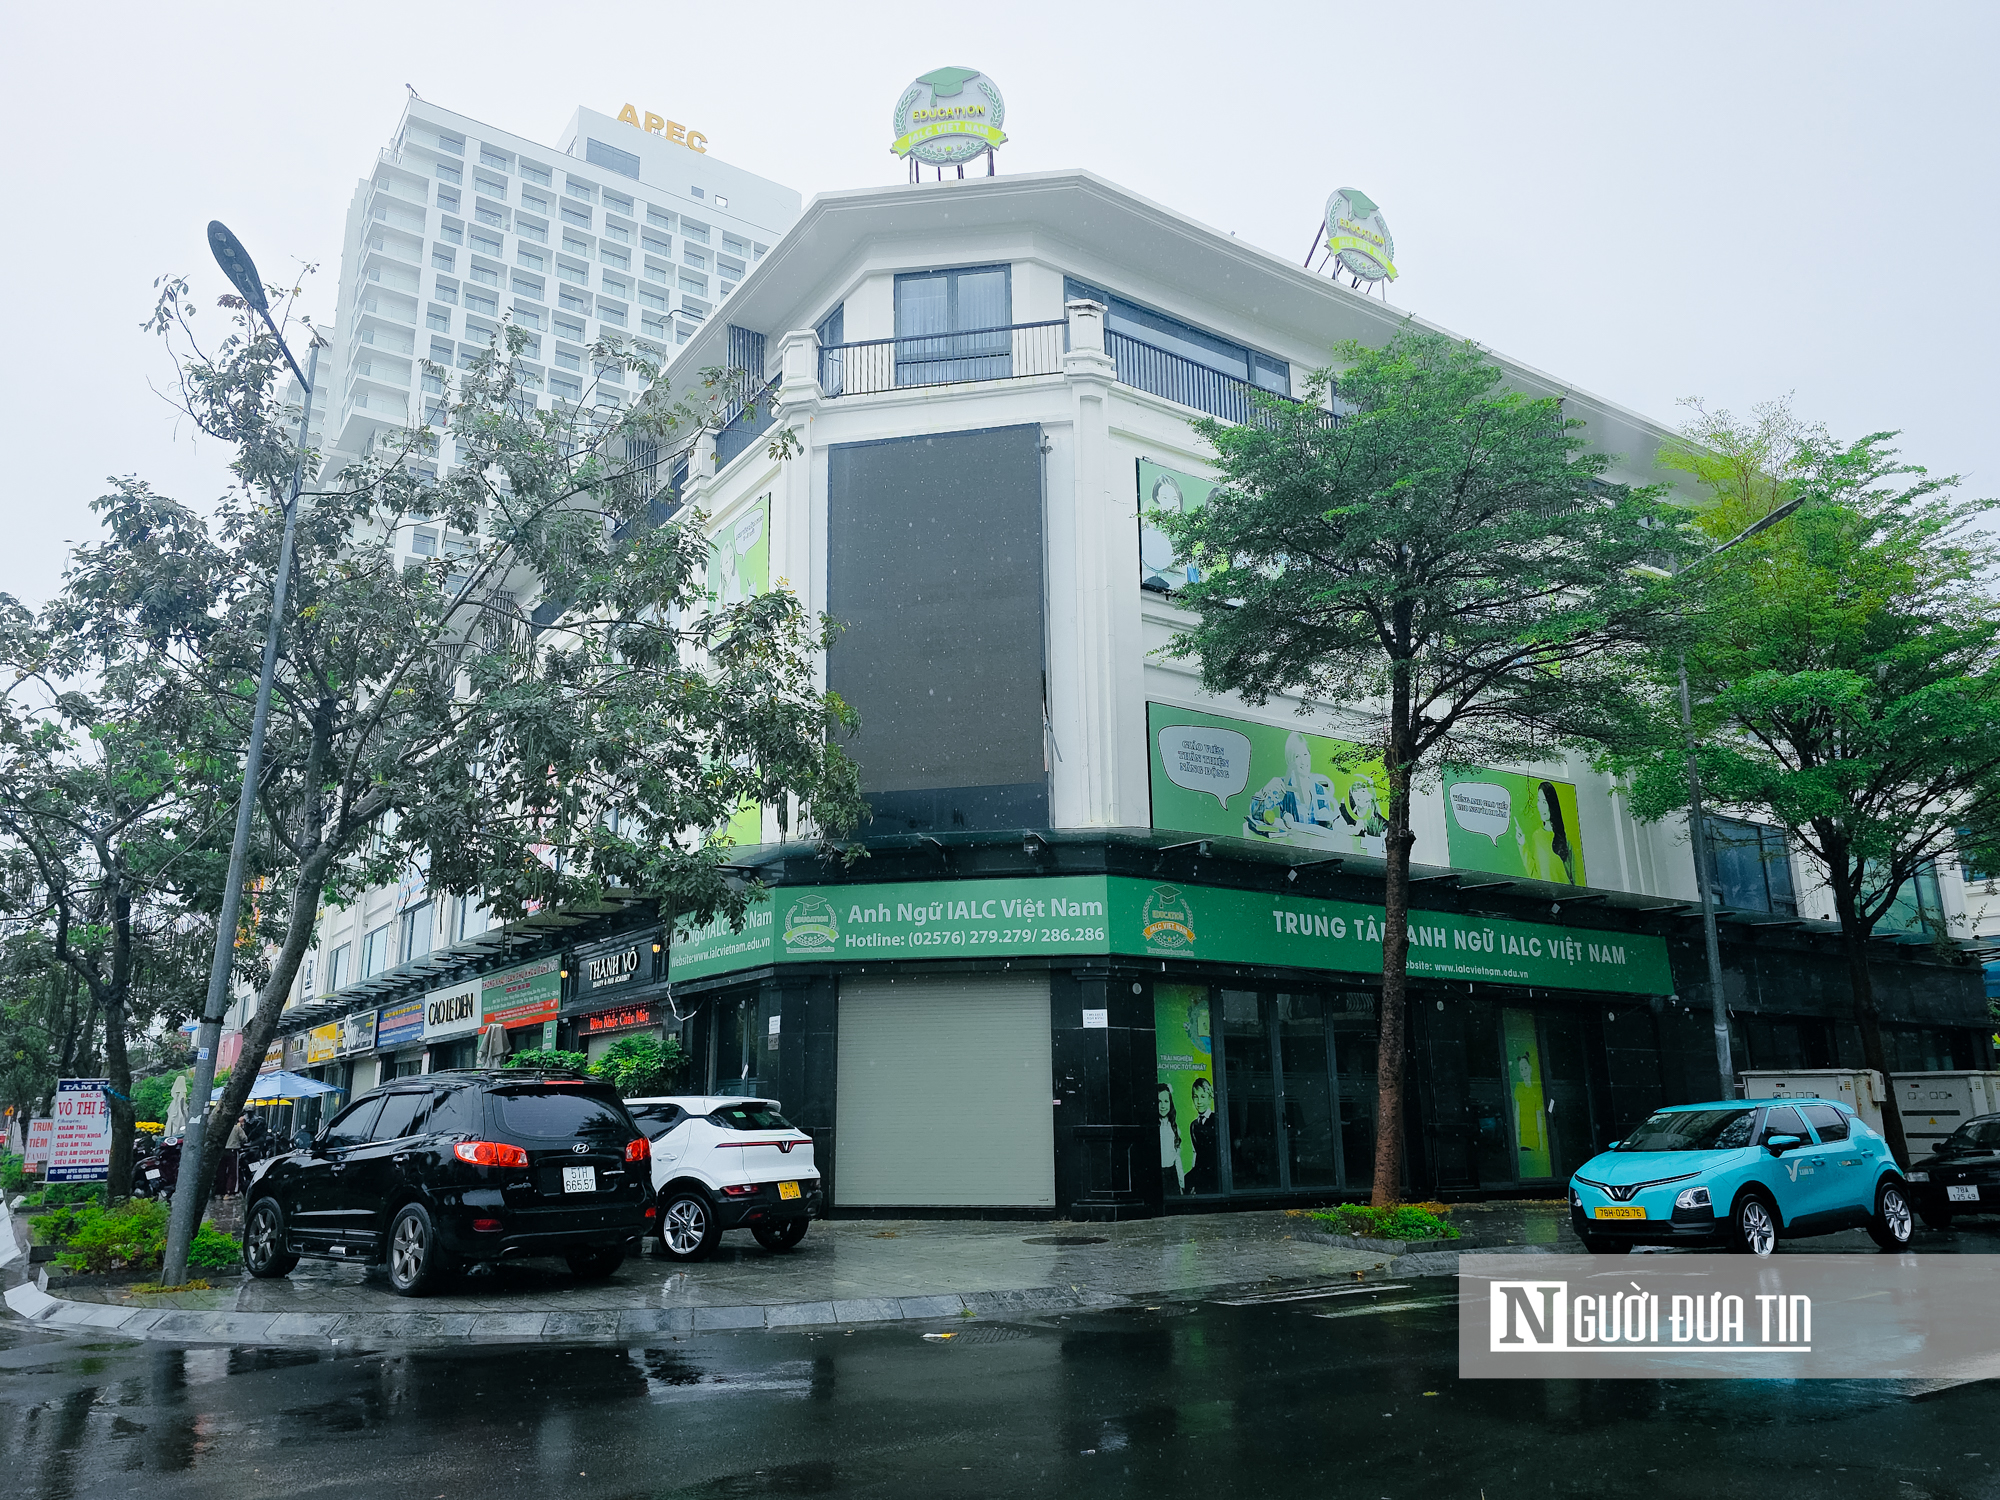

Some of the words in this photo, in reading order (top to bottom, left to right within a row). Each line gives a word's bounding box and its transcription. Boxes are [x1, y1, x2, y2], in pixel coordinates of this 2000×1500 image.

[912, 104, 986, 121] EDUCATION
[617, 103, 708, 154] APEC
[908, 127, 932, 144] IALC
[936, 122, 961, 133] VIET
[964, 122, 989, 136] NAM
[1338, 218, 1385, 245] EDUCATION
[749, 910, 773, 929] Nam
[848, 903, 891, 924] Anh
[897, 901, 943, 926] Ngữ
[947, 899, 997, 921] IALC
[1000, 898, 1045, 923] Việt
[1050, 898, 1103, 917] Nam
[845, 932, 905, 949] Hotline:
[908, 930, 966, 947] (02576)
[969, 928, 1038, 945] 279.279/
[1041, 927, 1105, 942] 286.286
[1272, 910, 1347, 939] TRUNG
[1407, 924, 1447, 949] ANH
[1453, 928, 1494, 953] NGỮ
[1500, 934, 1542, 958] IALC
[1547, 935, 1583, 966] VIỆT
[1588, 943, 1626, 965] NAM
[588, 955, 619, 981] THANH
[1434, 963, 1529, 979] www.ialcvietnam.edu.vn
[58, 1098, 73, 1116] VÕ
[76, 1101, 97, 1119] THỊ
[33, 1122, 54, 1131] TRUN
[571, 1168, 588, 1179] 51H
[565, 1179, 594, 1192] 665.57
